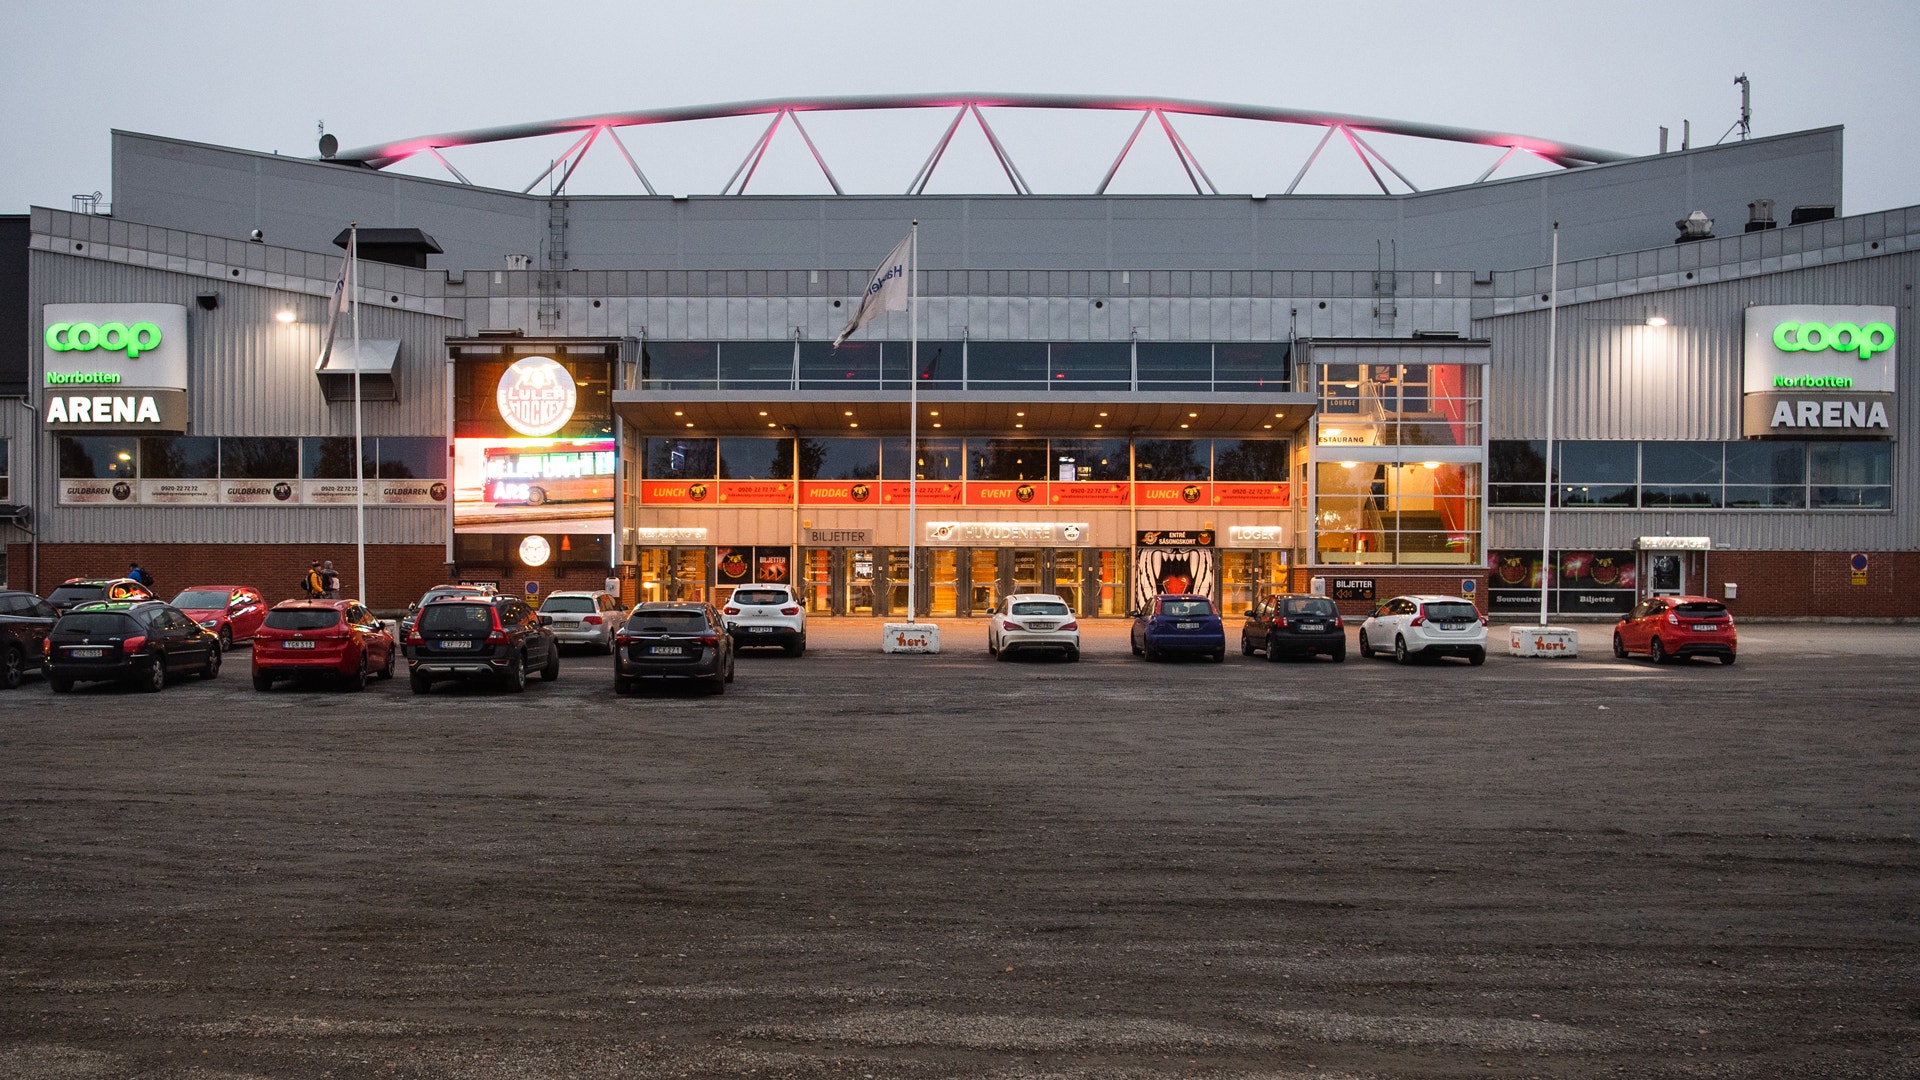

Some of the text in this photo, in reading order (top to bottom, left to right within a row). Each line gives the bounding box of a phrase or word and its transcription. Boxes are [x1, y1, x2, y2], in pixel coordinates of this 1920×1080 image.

[45, 322, 162, 358] coop
[1773, 322, 1896, 359] coop
[46, 371, 121, 384] Norrbotten
[1773, 374, 1853, 387] Norrbotten
[46, 396, 161, 423] ARENA
[1771, 401, 1889, 428] ARENA
[67, 487, 111, 495] GULDBAREN
[228, 487, 271, 495] GULDBAREN
[383, 487, 428, 495] GULDBAREN
[653, 487, 686, 497] LUNCH
[809, 488, 848, 498] MIDDAG
[980, 489, 1013, 498] EVENT
[1146, 490, 1179, 499] LUNCH
[812, 531, 865, 541] BILJETTER
[760, 556, 786, 564] BILJETTER
[1336, 580, 1373, 588] BILJETTER
[1580, 595, 1615, 604] Biljetter
[896, 632, 928, 647] heri
[1535, 636, 1566, 650] heri
